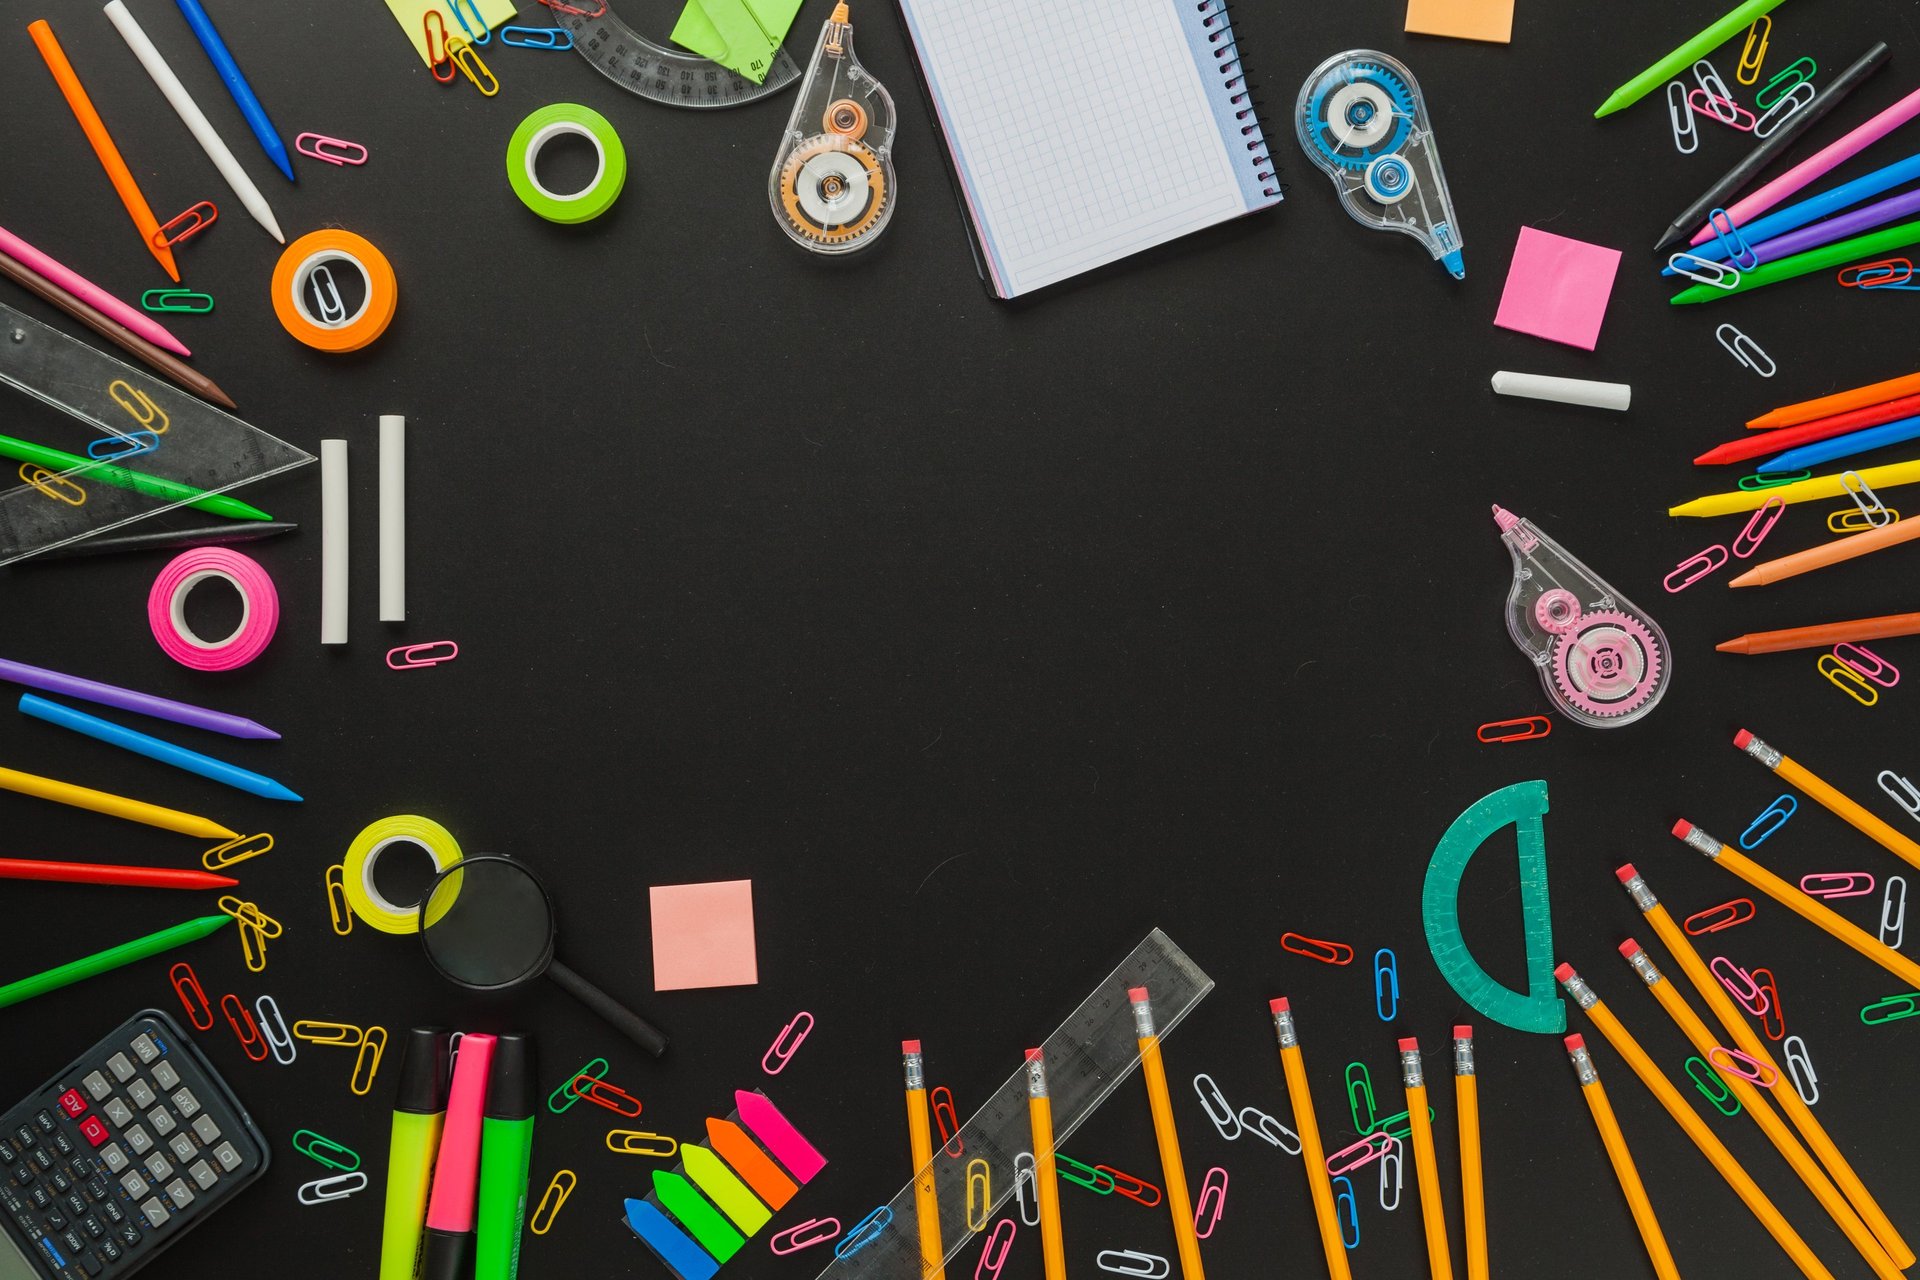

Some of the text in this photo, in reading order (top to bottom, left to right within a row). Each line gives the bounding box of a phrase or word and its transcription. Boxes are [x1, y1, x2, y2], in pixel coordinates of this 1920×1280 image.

[597, 27, 610, 41] 100
[589, 39, 599, 50] 80
[616, 45, 628, 56] 110
[608, 56, 618, 68] 70
[635, 57, 648, 68] 120
[749, 58, 763, 70] 170
[783, 60, 788, 68] 0
[630, 70, 641, 80] 60
[657, 65, 670, 76] 130
[680, 70, 694, 80] 140
[704, 71, 717, 81] 150
[758, 72, 765, 82] 10
[655, 79, 665, 89] 50
[681, 84, 691, 94] 40
[707, 84, 717, 94] 30
[733, 81, 743, 91] 20
[1139, 962, 1148, 971] 29
[1103, 999, 1112, 1008] 27
[1085, 1017, 1095, 1027] 26
[137, 1042, 153, 1058] M+
[1049, 1054, 1058, 1064] 24
[1031, 1072, 1041, 1082] 23
[1080, 1069, 1087, 1077] 2
[63, 1094, 83, 1114] AC
[176, 1094, 195, 1113] EXP
[155, 1114, 168, 1127] 3
[995, 1111, 1004, 1119] 21
[38, 1114, 52, 1129] MR
[20, 1128, 32, 1143] tan
[86, 1123, 100, 1137] C
[57, 1136, 70, 1151] Min
[132, 1133, 144, 1146] 6
[176, 1141, 190, 1154] 2
[36, 1151, 49, 1165] cos
[108, 1152, 120, 1164] 9
[220, 1150, 233, 1163] 0
[151, 1160, 165, 1173] 5
[198, 1170, 206, 1179] 1
[55, 1174, 66, 1187] sin
[128, 1178, 141, 1191] 8
[173, 1187, 184, 1197] 4
[924, 1185, 932, 1193] 17
[34, 1189, 45, 1203] log
[70, 1196, 82, 1211] hyp
[106, 1202, 121, 1220] ENG
[148, 1209, 160, 1219] 7
[65, 1232, 80, 1250] MODE
